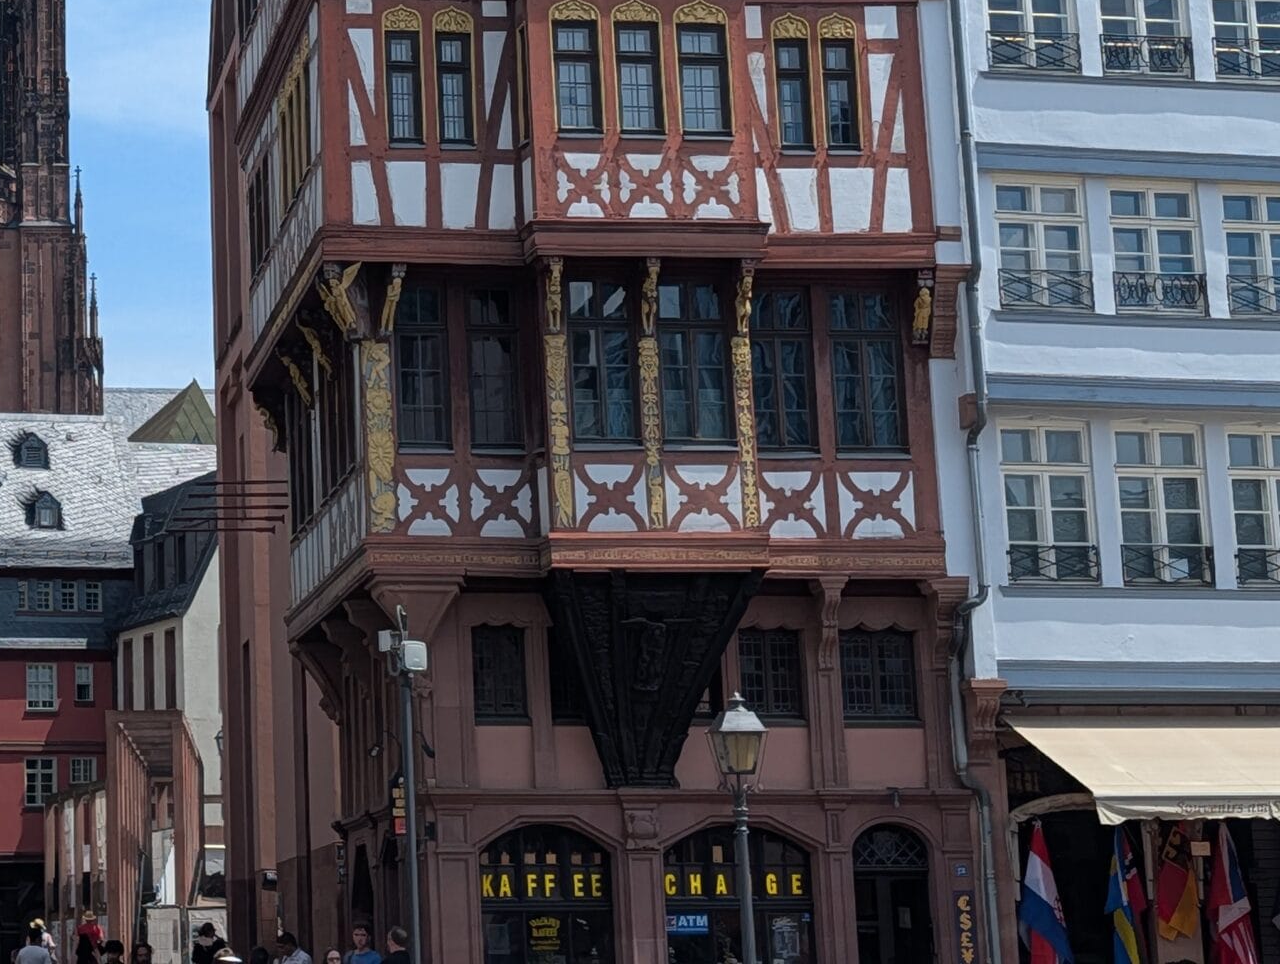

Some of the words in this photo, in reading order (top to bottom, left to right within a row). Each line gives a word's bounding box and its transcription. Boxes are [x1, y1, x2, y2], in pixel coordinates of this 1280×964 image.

[482, 873, 603, 898] KAFFEE
[664, 873, 804, 895] CHAGE
[679, 915, 709, 927] ATM
